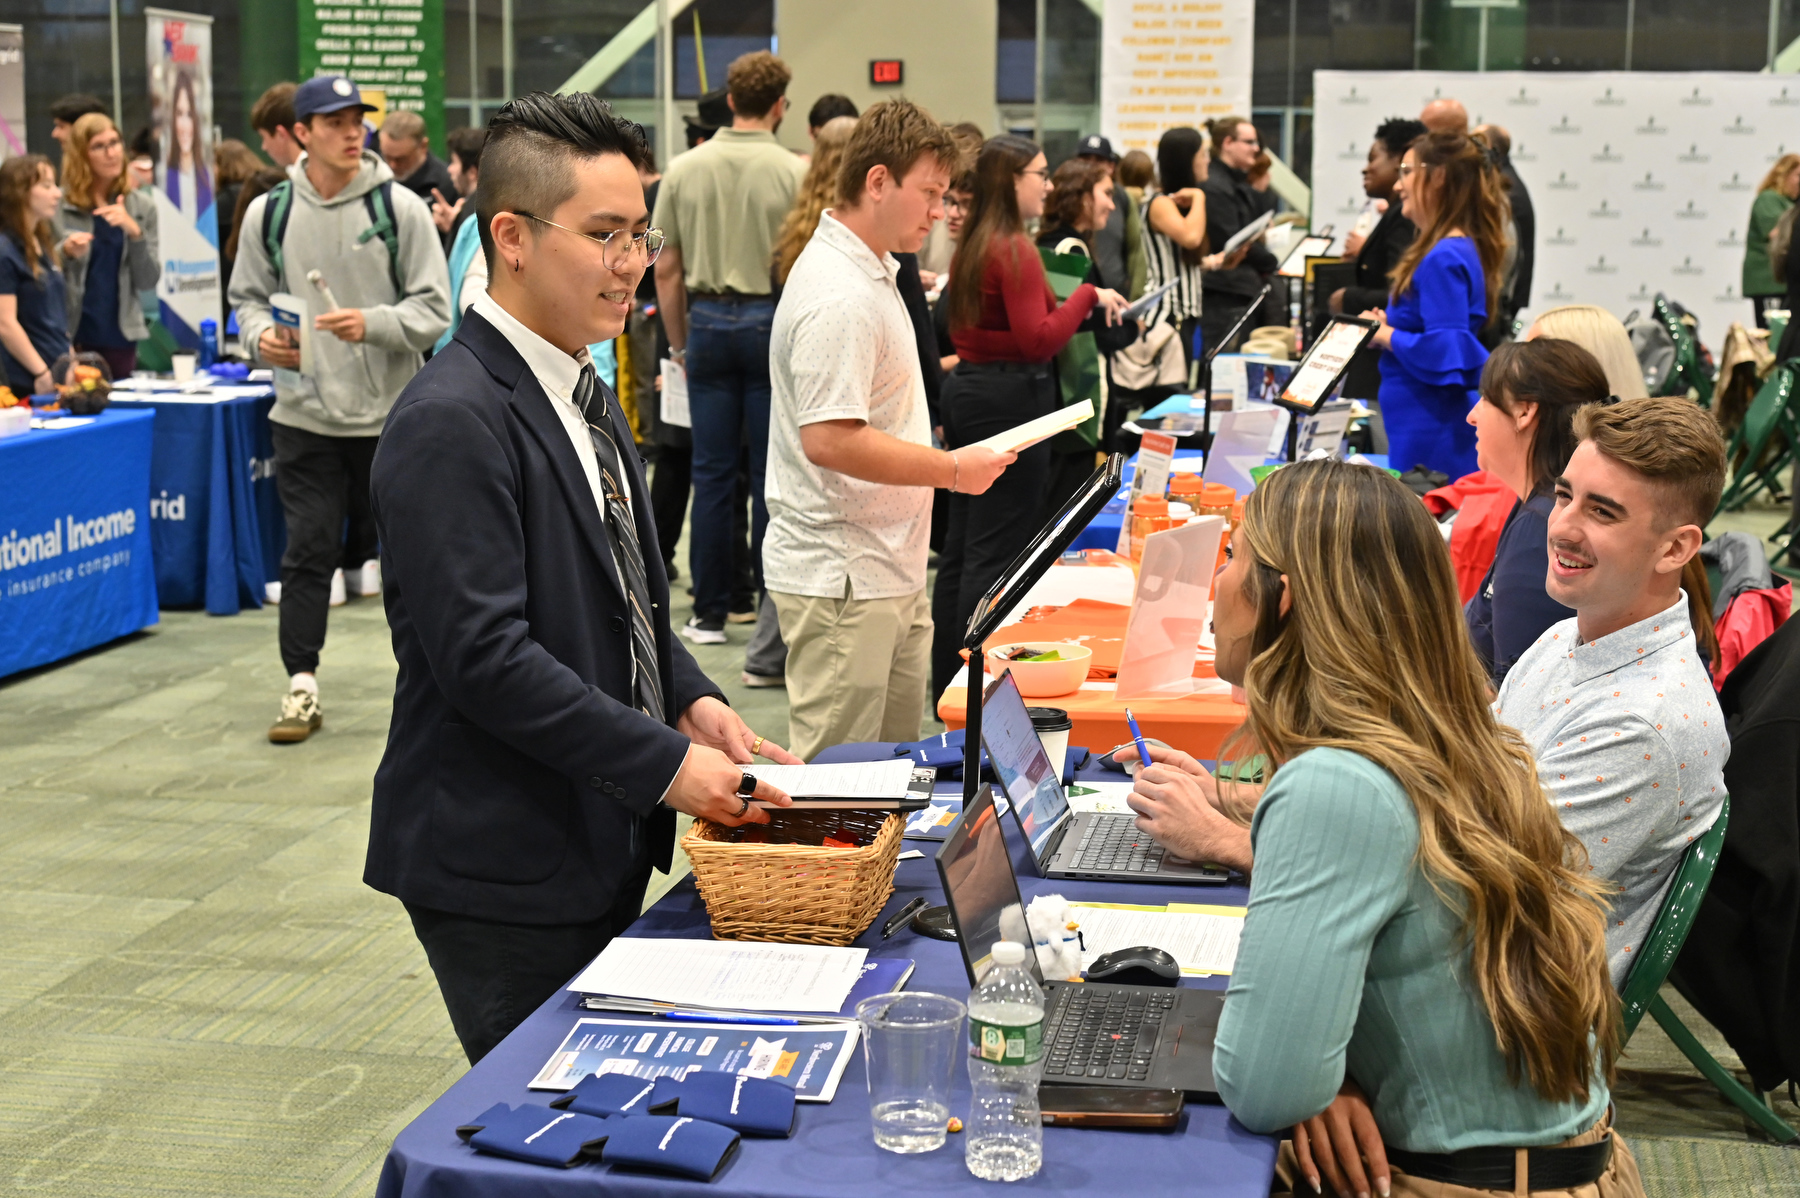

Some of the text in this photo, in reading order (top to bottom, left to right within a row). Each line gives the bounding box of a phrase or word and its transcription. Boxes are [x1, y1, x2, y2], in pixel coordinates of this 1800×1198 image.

[67, 508, 136, 552] Income
[7, 566, 74, 597] insurance
[77, 549, 131, 575] company
